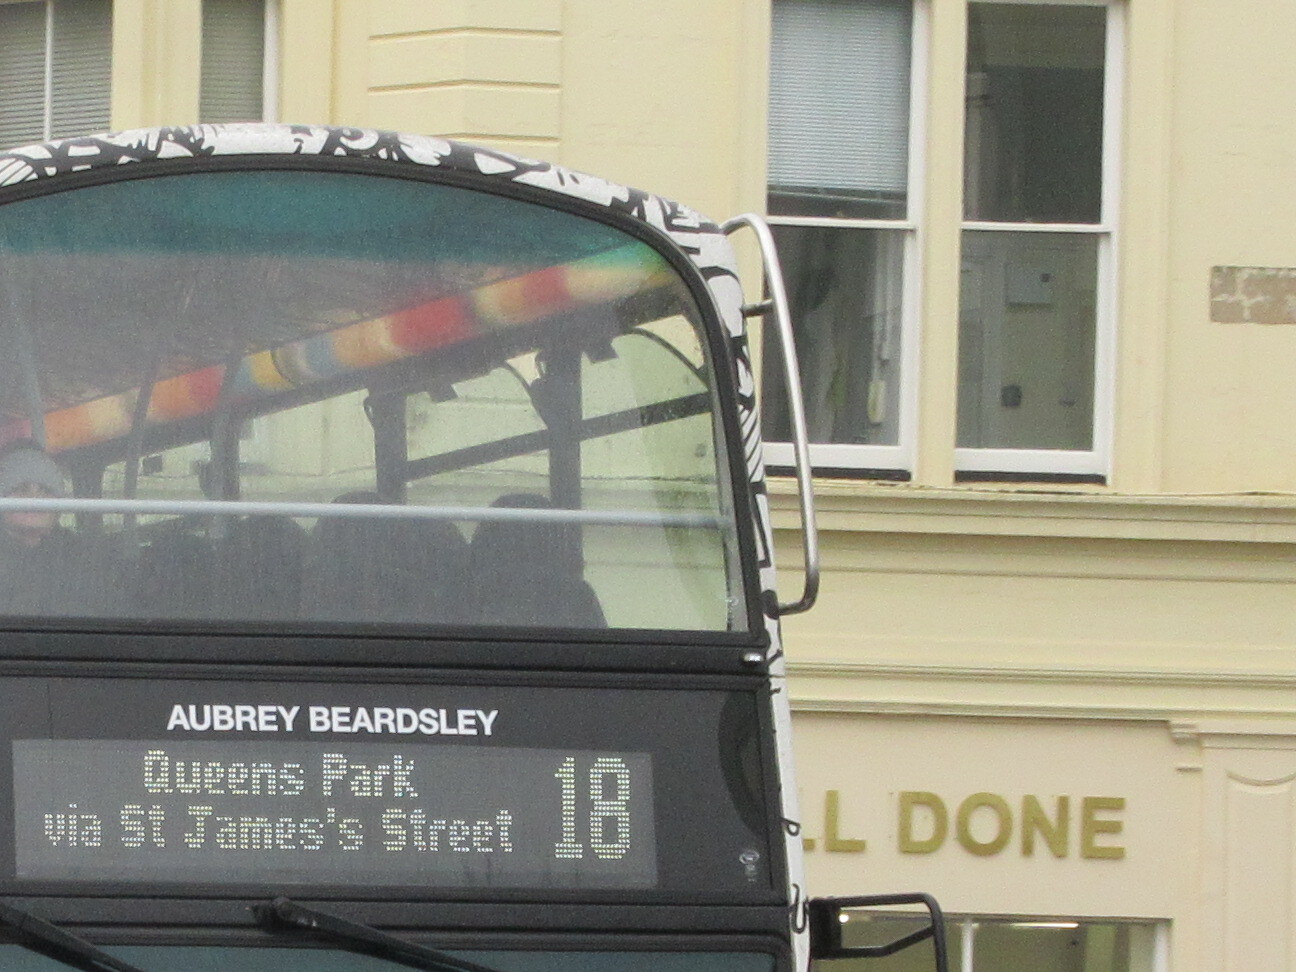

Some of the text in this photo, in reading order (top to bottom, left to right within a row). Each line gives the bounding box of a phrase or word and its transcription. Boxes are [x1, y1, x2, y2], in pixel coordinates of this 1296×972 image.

[166, 704, 498, 737] AUBREY BEARDSLEY
[143, 750, 418, 799] Queens Park
[44, 804, 513, 853] via St James's Street
[554, 756, 633, 860] 18
[897, 791, 1126, 860] DONE
